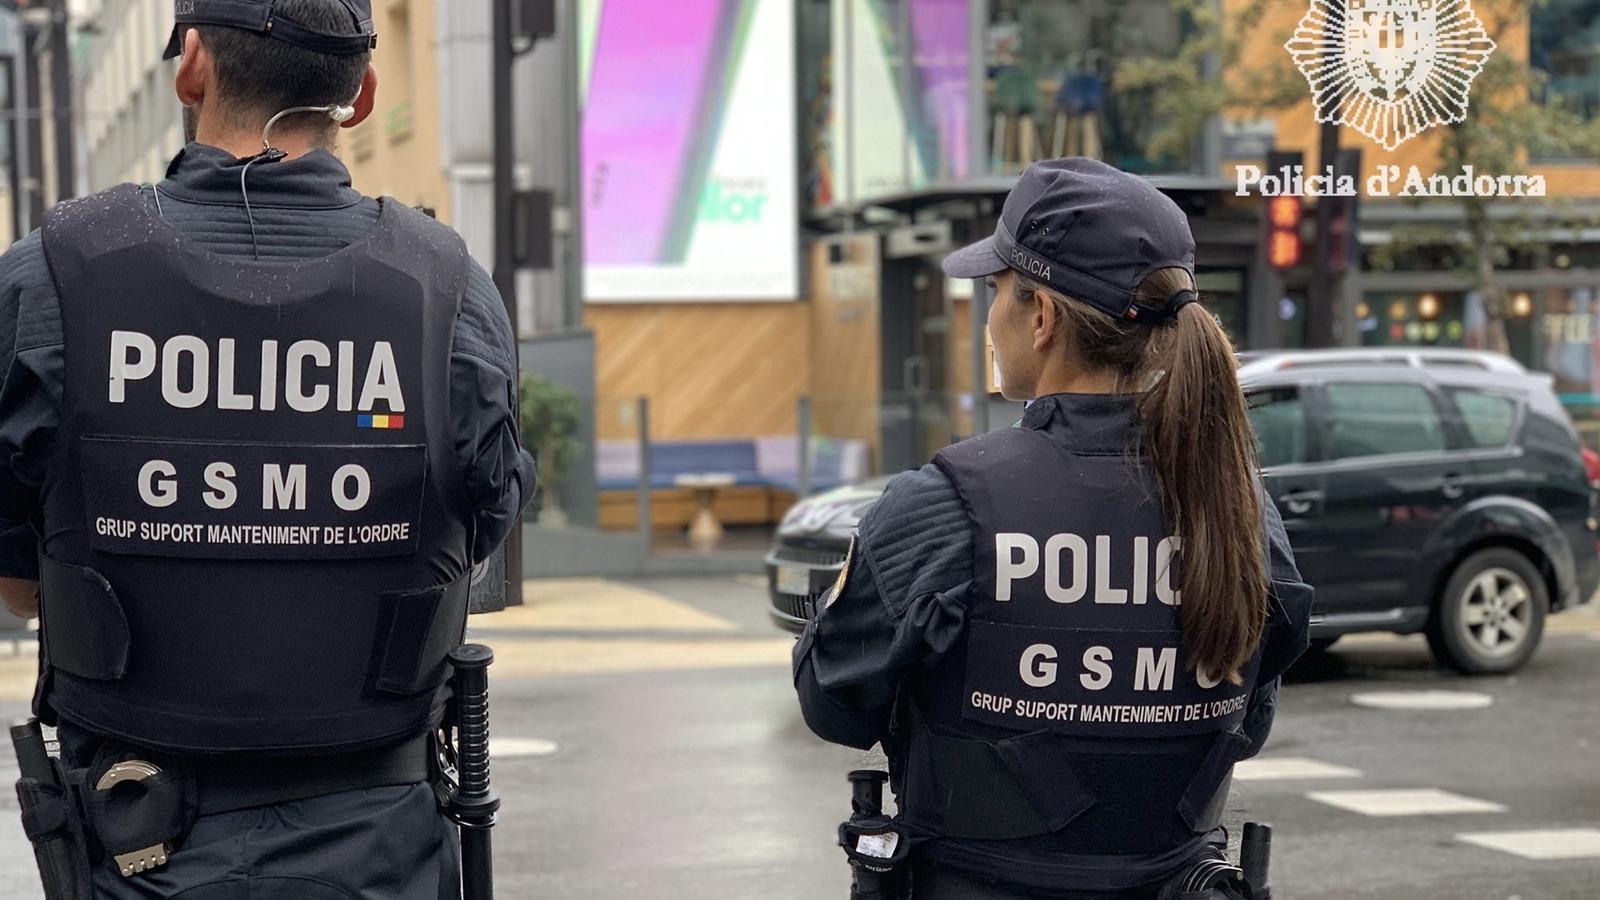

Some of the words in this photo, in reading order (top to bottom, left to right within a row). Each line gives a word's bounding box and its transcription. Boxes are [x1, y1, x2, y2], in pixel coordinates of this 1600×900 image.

[1011, 249, 1050, 281] POLICIA
[108, 330, 406, 412] POLICIA
[96, 516, 137, 539] GRUP
[140, 521, 204, 543] SUPORT
[207, 524, 321, 545] MANTENIMENT
[323, 526, 345, 545] DE
[348, 522, 410, 544] L'ORDRE
[995, 532, 1181, 605] POLIC
[971, 691, 1013, 714] GRUP
[1015, 699, 1078, 721] SUPORT
[1079, 704, 1183, 723] MANTENIMENT
[1183, 703, 1202, 721] DE
[1203, 693, 1239, 719] L'ORDRE
